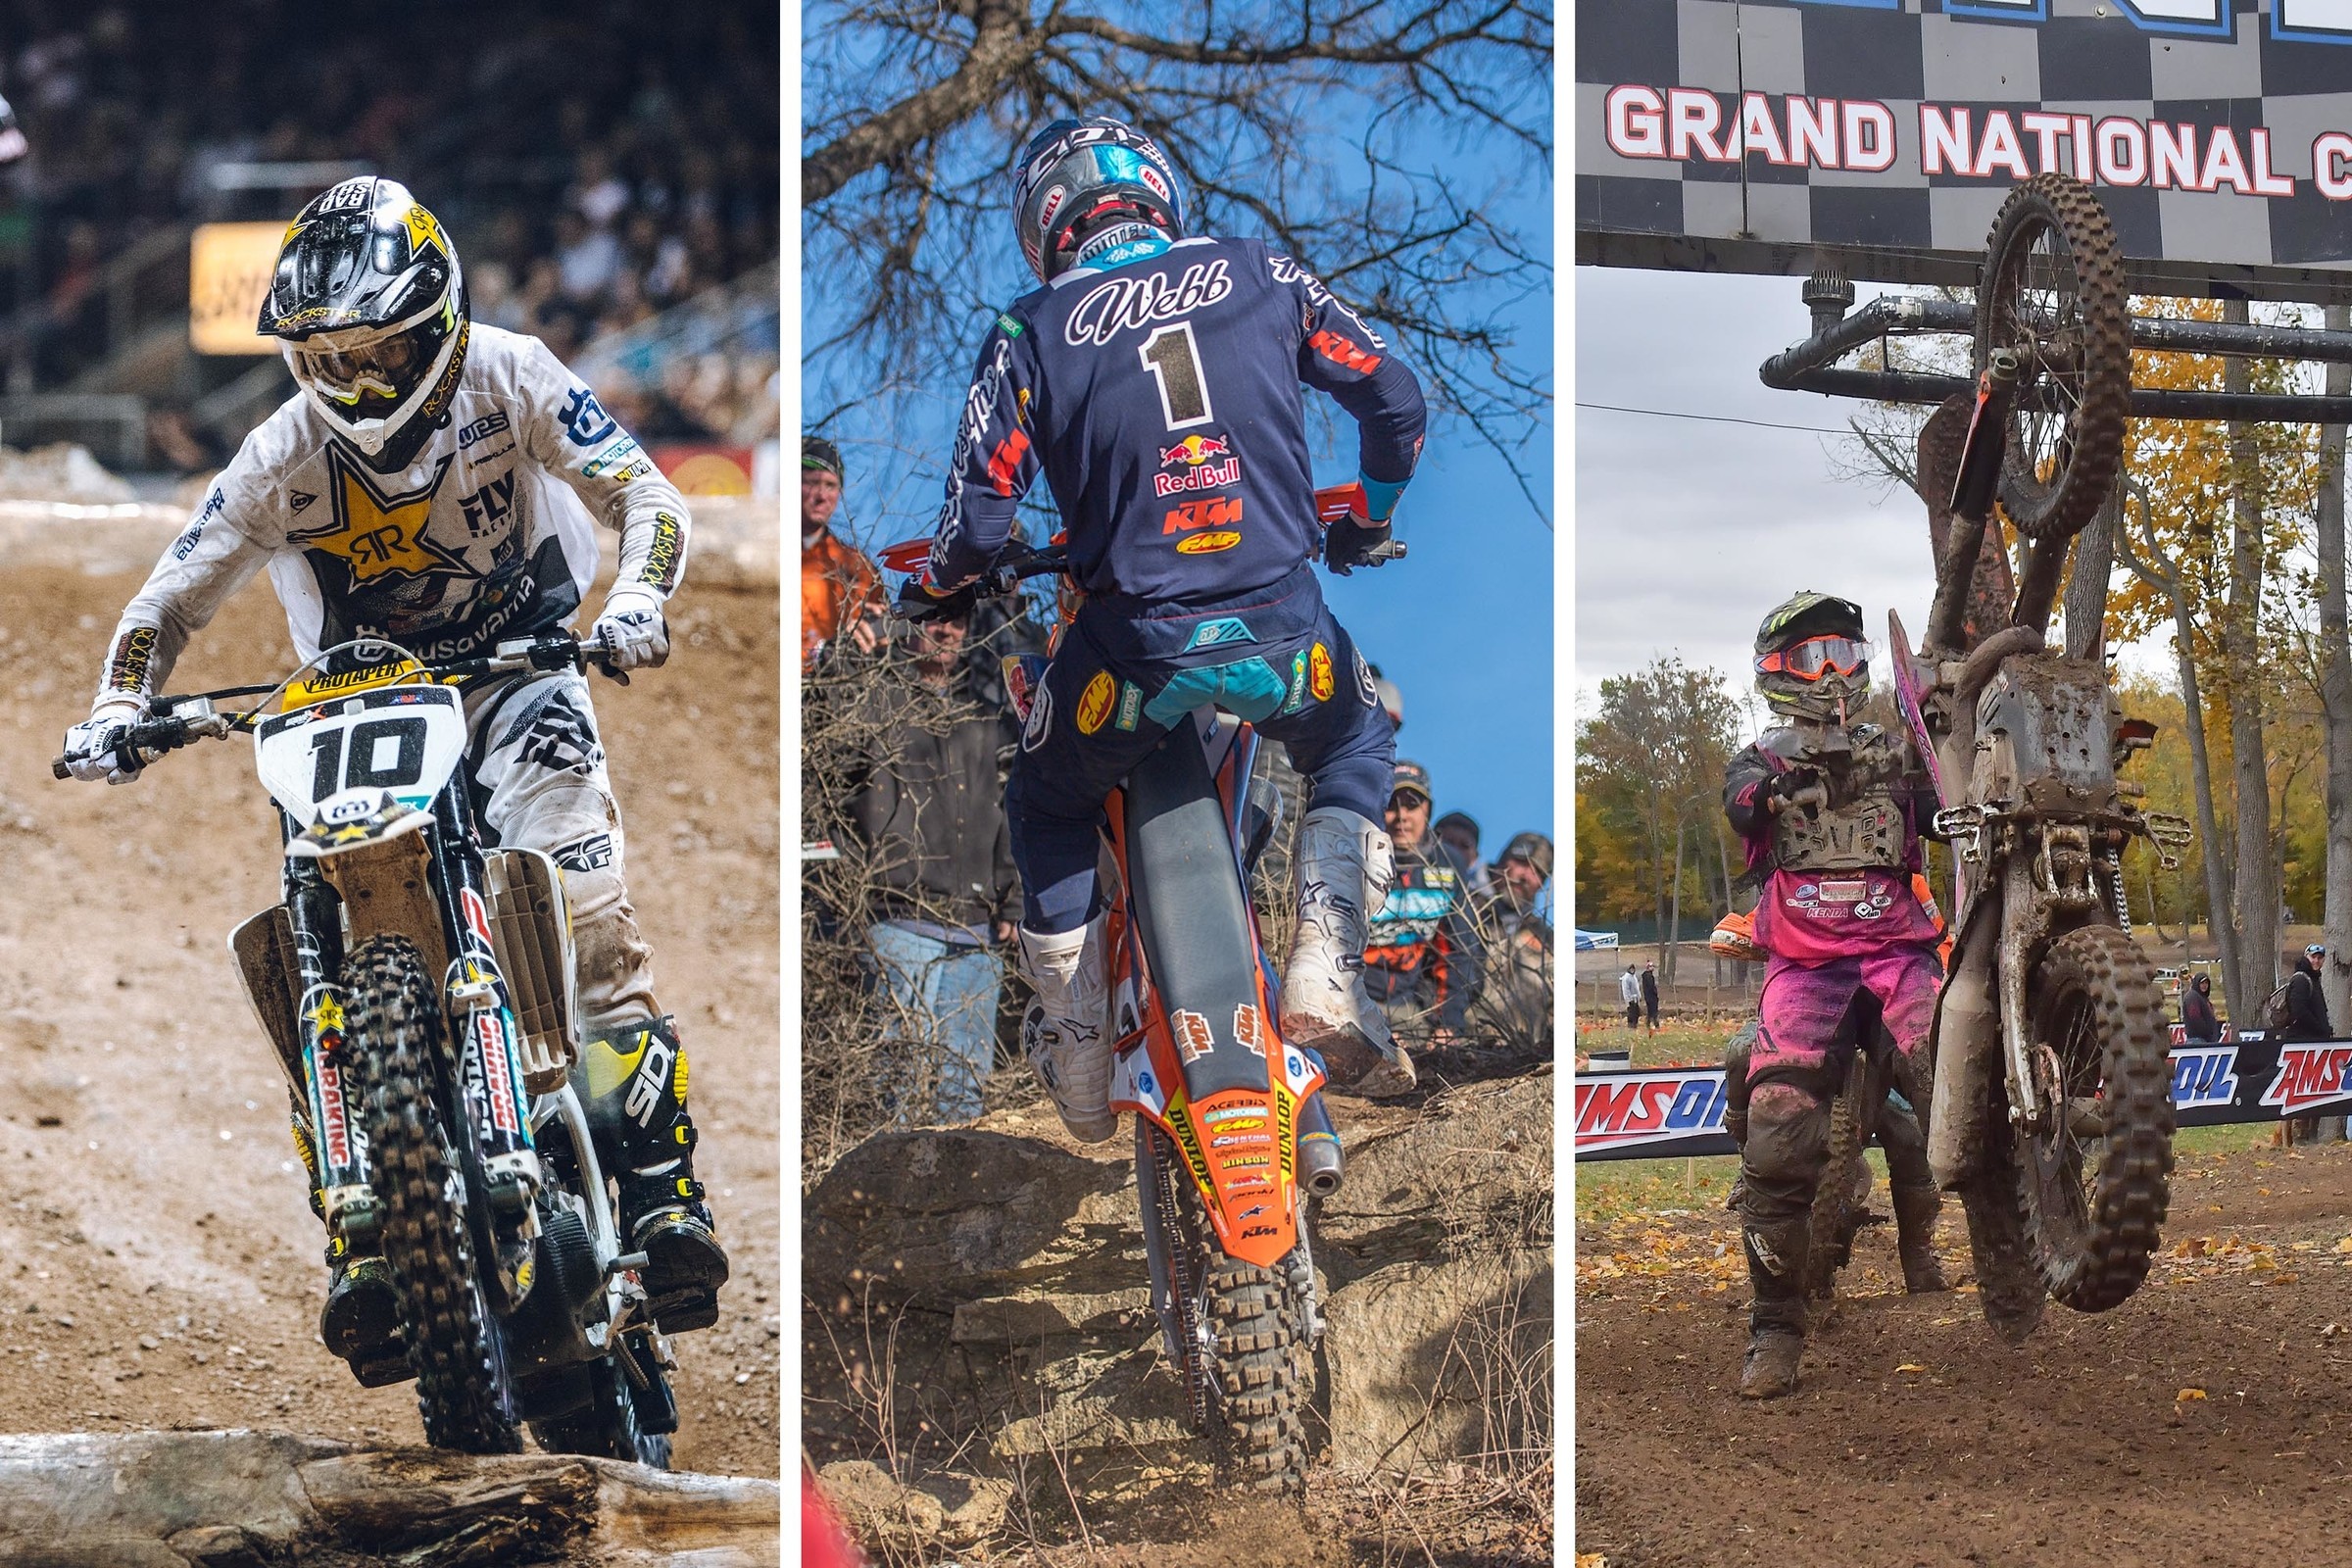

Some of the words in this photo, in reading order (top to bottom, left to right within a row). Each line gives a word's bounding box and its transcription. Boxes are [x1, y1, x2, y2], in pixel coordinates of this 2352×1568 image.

[1606, 84, 1897, 172] GRAND
[1919, 103, 2296, 196] NATIONAL
[1143, 169, 1169, 200] BELL
[1041, 193, 1063, 227] BELL
[1064, 259, 1233, 347] Webb
[1307, 328, 1382, 376] KTM
[1138, 319, 1214, 432] 1
[1153, 465, 1200, 498] Red
[1200, 456, 1242, 489] Bull
[457, 467, 514, 535] FLY
[1162, 496, 1244, 535] KTM
[1177, 532, 1242, 554] FMF
[309, 662, 401, 693] PROTAPER
[1079, 670, 1114, 734] FMF
[309, 717, 428, 805] 10
[1807, 907, 1849, 918] KENDA
[1184, 1014, 1210, 1053] KTM
[1238, 1005, 1255, 1047] KTM
[478, 1014, 518, 1134] BRAKING
[1206, 1099, 1267, 1113] ACERBIS
[1169, 1108, 1213, 1187] DUNLOP
[1277, 1090, 1293, 1176] DUNLOP
[1241, 1225, 1279, 1240] KTM
